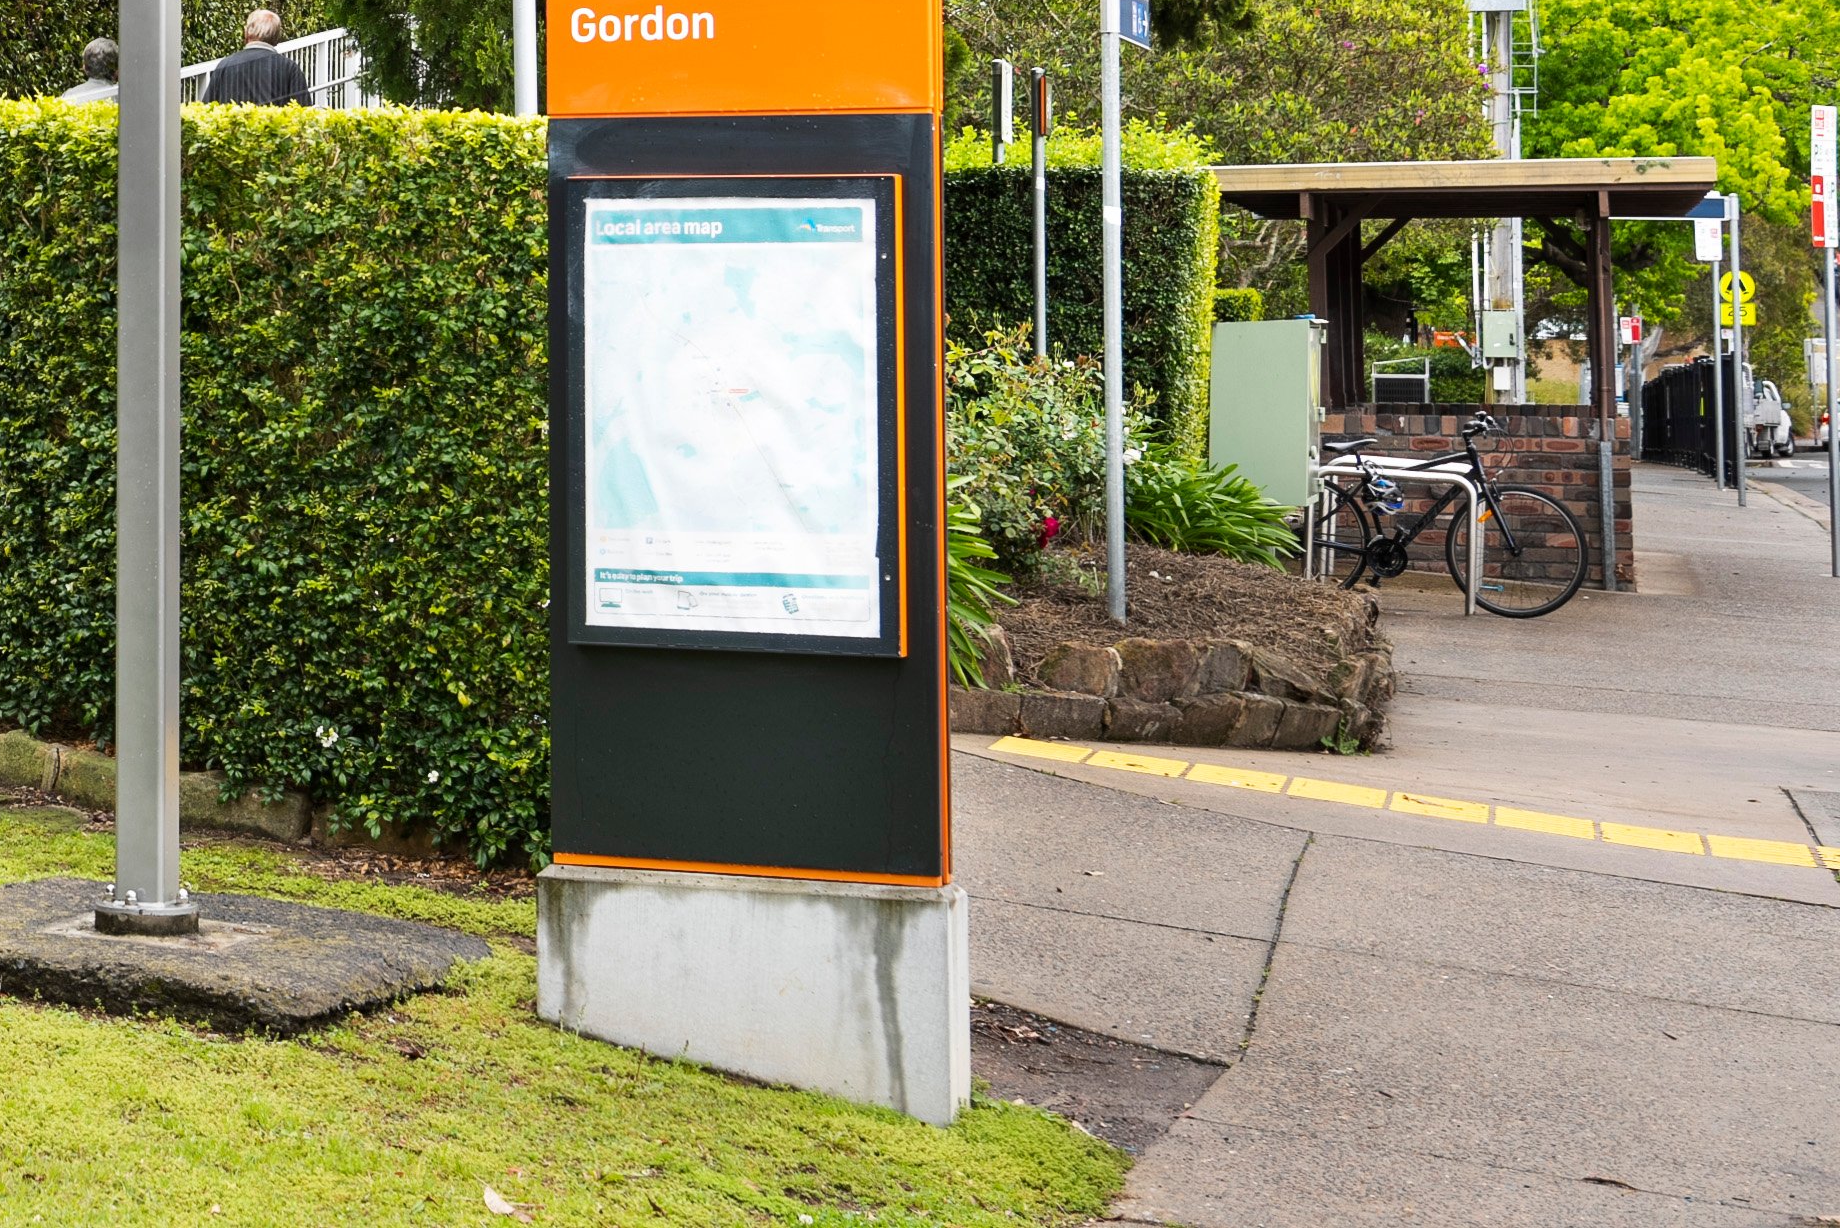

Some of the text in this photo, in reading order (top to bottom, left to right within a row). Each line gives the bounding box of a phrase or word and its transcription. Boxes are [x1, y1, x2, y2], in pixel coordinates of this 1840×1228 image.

[571, 5, 714, 43] Gordon
[596, 219, 723, 238] Local area map
[816, 224, 856, 234] Transport
[637, 573, 653, 582] plan
[669, 574, 683, 583] trip
